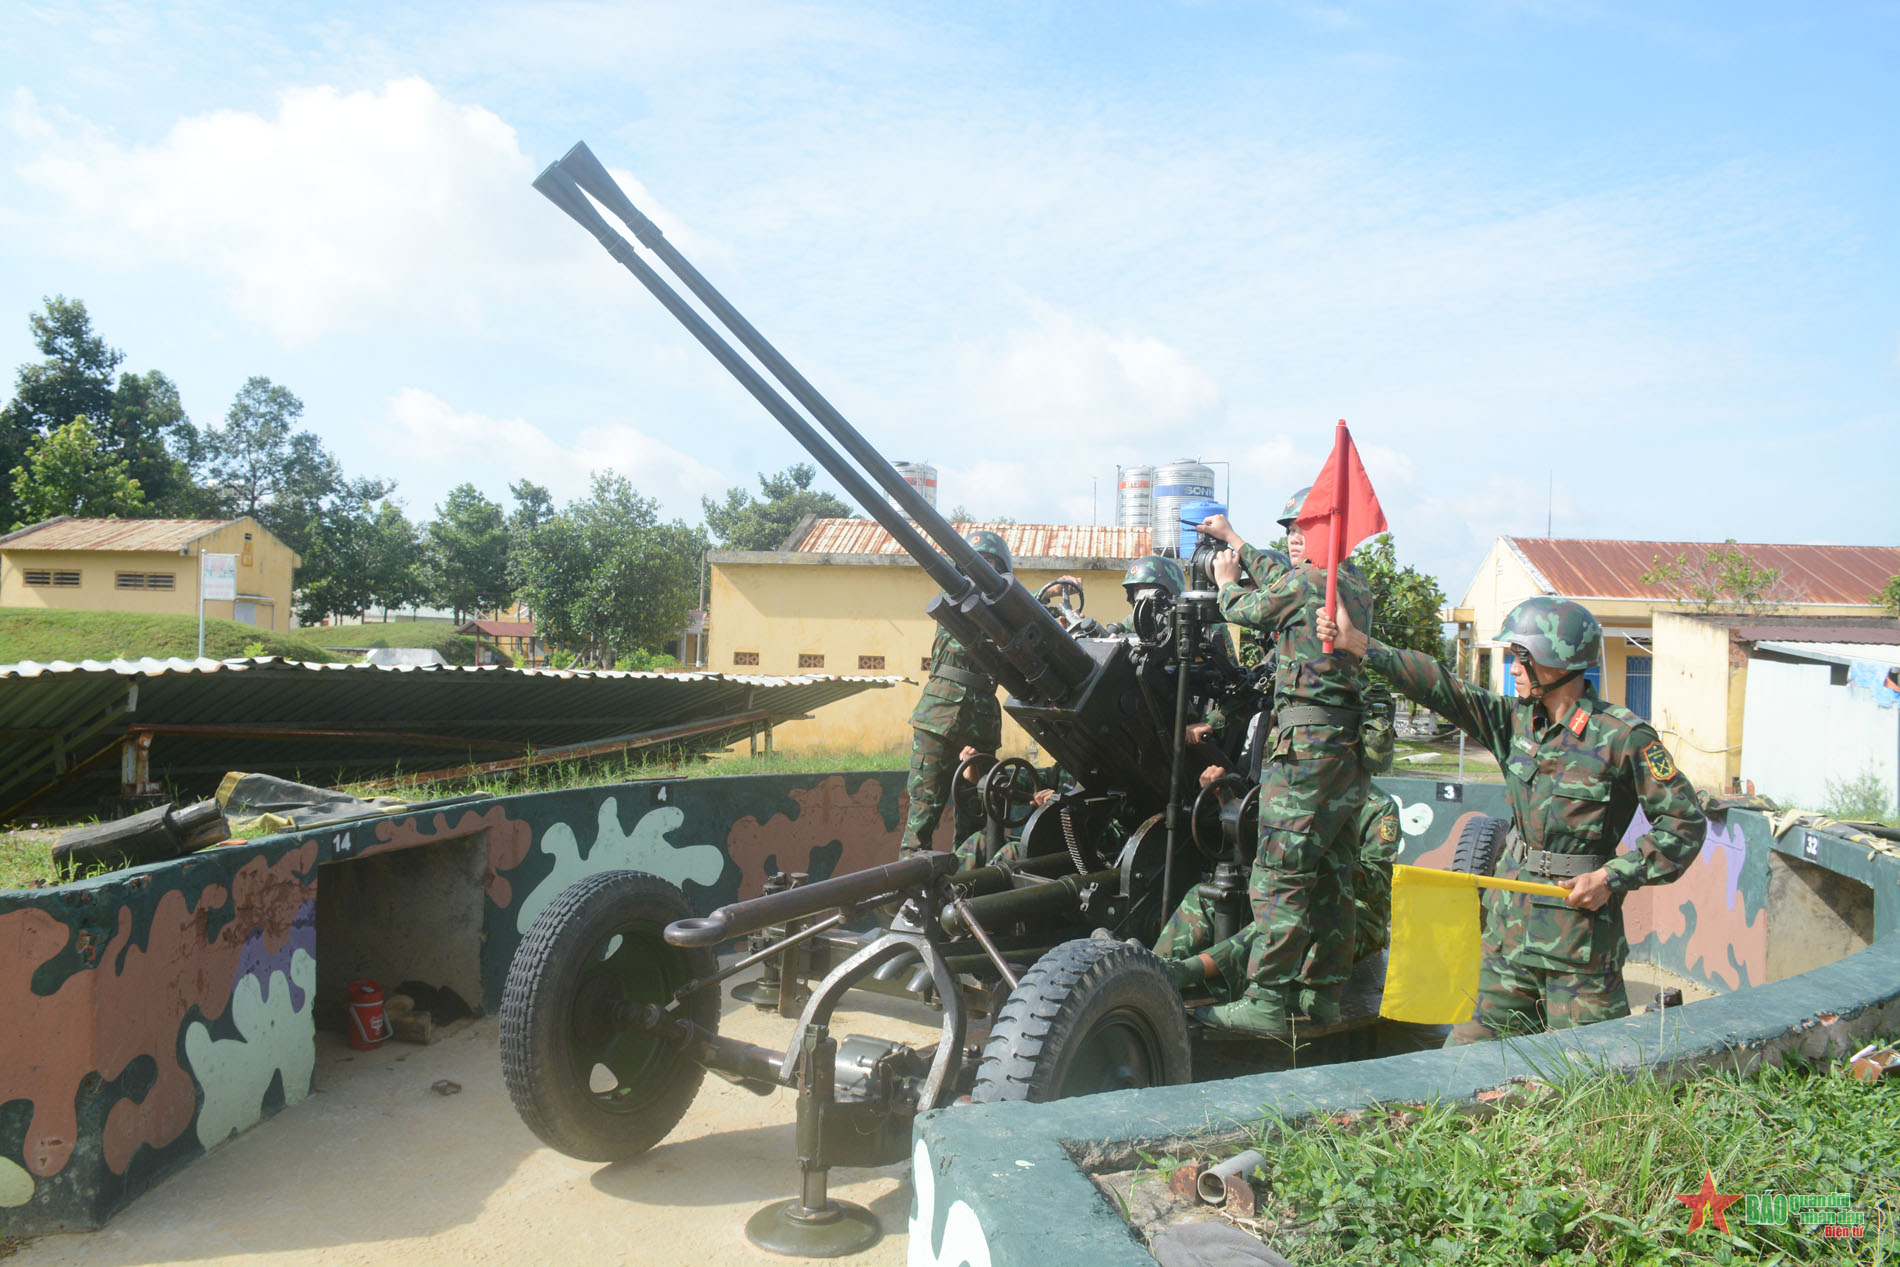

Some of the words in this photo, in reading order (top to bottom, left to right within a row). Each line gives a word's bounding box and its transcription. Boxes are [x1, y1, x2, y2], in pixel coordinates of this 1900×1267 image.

[657, 786, 667, 801] 4
[1444, 785, 1455, 799] 3
[333, 832, 351, 852] 14
[1806, 836, 1818, 855] 32
